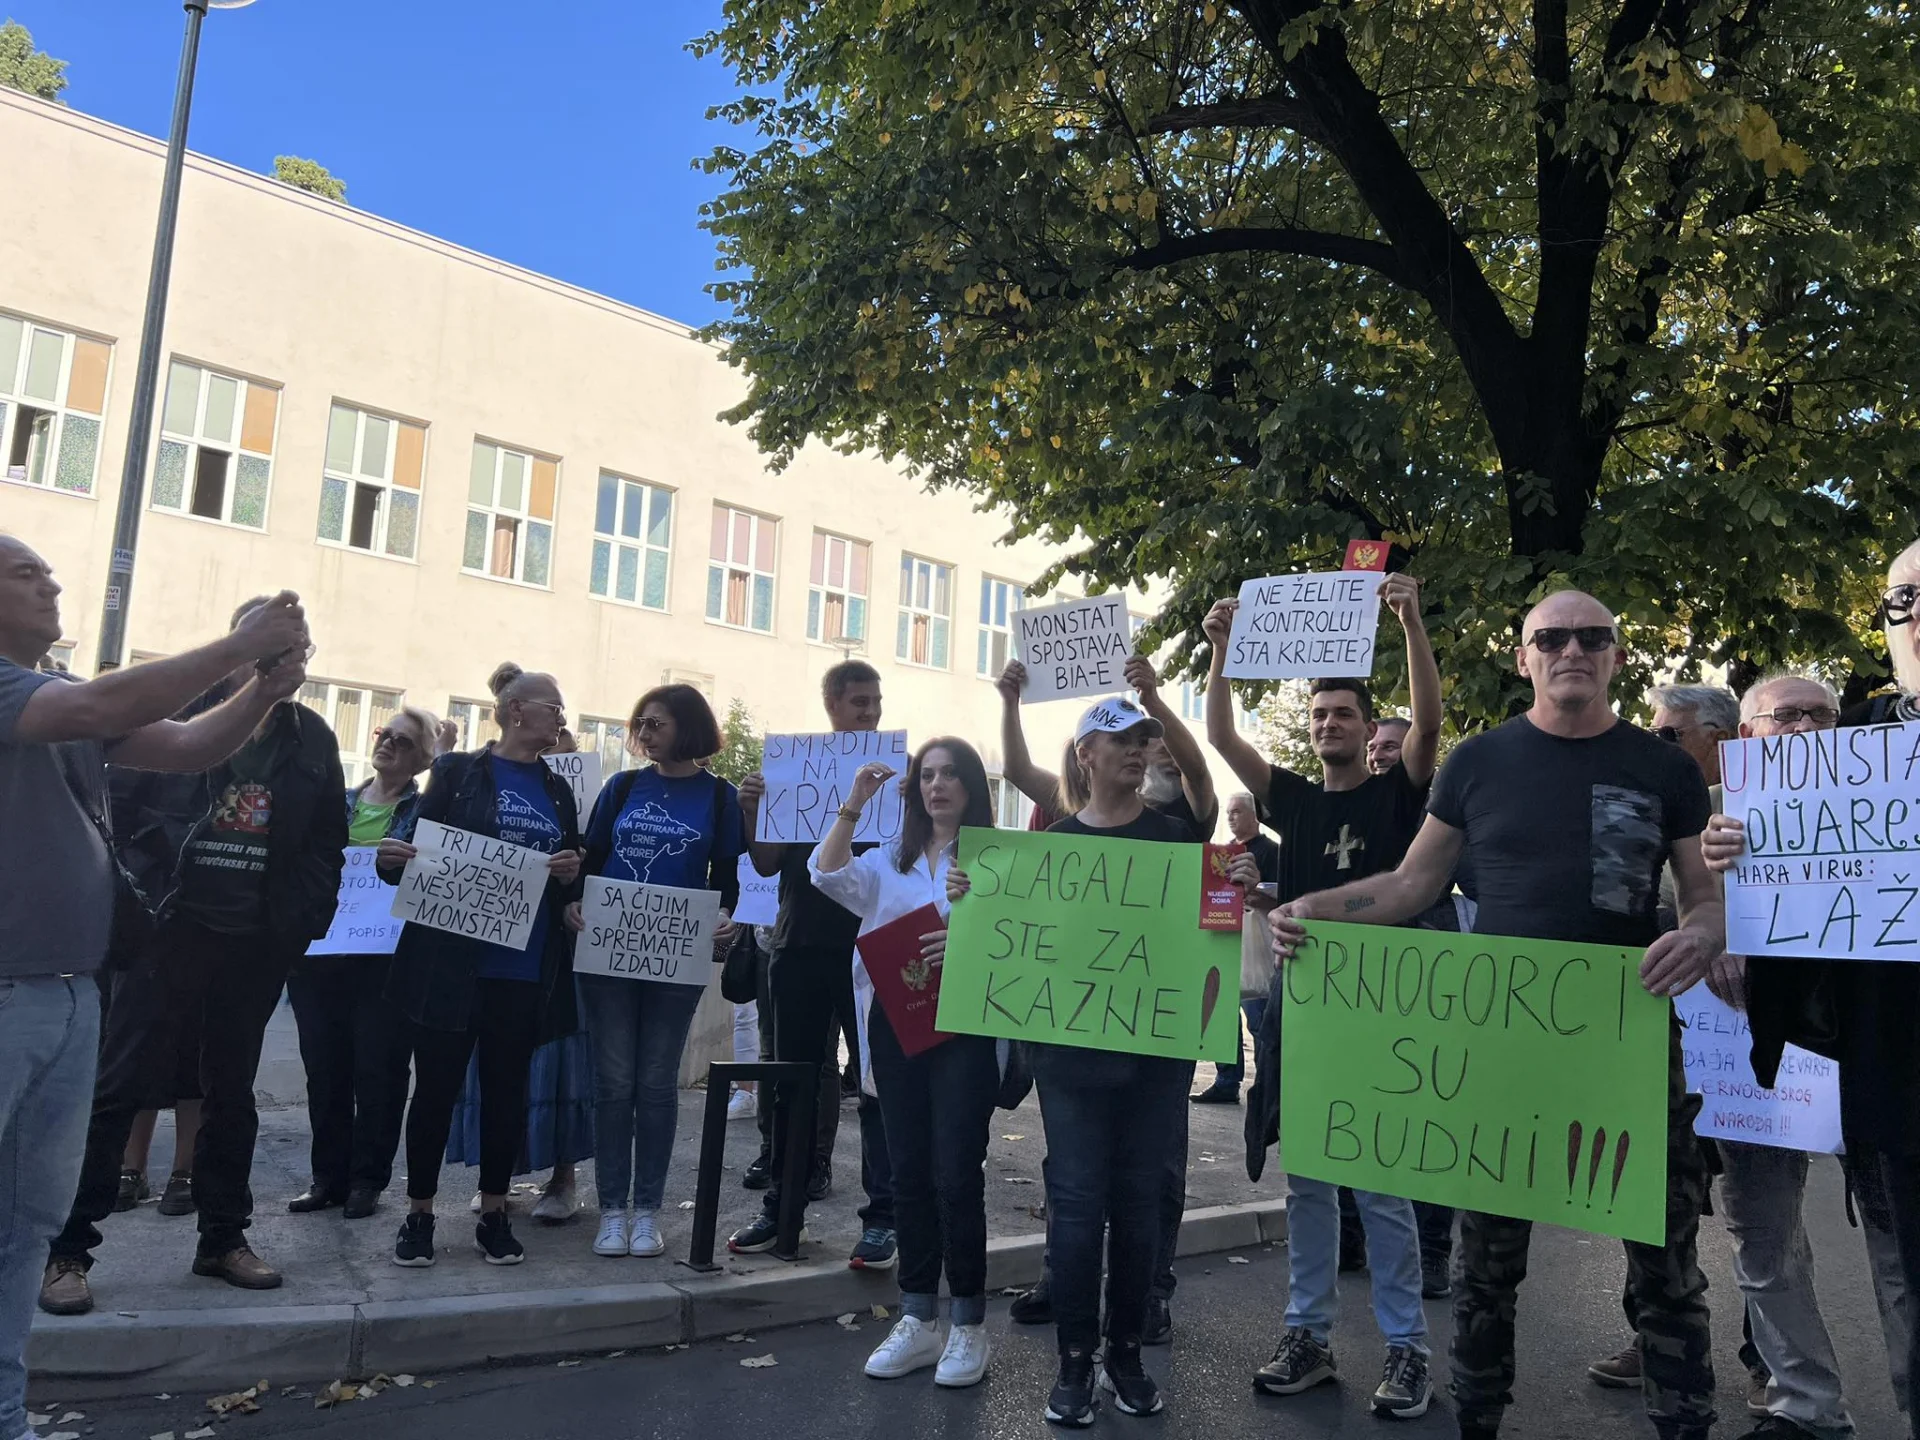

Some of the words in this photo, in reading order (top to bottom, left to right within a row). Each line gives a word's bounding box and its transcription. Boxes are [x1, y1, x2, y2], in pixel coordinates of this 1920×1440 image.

[1255, 584, 1284, 607] NE
[1292, 576, 1365, 602] ŽELITE
[1022, 604, 1118, 640] MONSTAT
[1026, 633, 1127, 665] ISPOSTAVA
[1233, 636, 1269, 665] ŠTA
[1278, 637, 1371, 667] KRIJETE?
[1055, 661, 1112, 690] BIA-E
[1089, 706, 1125, 728] MNE
[803, 758, 838, 781] NA
[1721, 740, 1747, 793] U
[503, 816, 553, 834] POTIRANJE
[621, 821, 633, 829] NA
[635, 822, 687, 835] POTIRANJE
[633, 812, 667, 823] BOJKOT
[440, 826, 472, 854] TRI
[500, 830, 527, 843] CRNE
[631, 834, 657, 845] CRNE
[973, 845, 1175, 909] SLAGALI
[1736, 864, 1790, 885] HARA
[601, 887, 625, 909] SA
[631, 887, 689, 917] ČIJIM
[348, 925, 386, 938] POPIS
[619, 911, 700, 937] NOVCEM
[591, 927, 694, 957] SPREMATE
[988, 918, 1059, 963] STE
[1087, 929, 1151, 977] ZA
[609, 952, 678, 978] IZDAJU
[1286, 935, 1627, 1042] CRNOGORCI
[1371, 1037, 1468, 1100] SU
